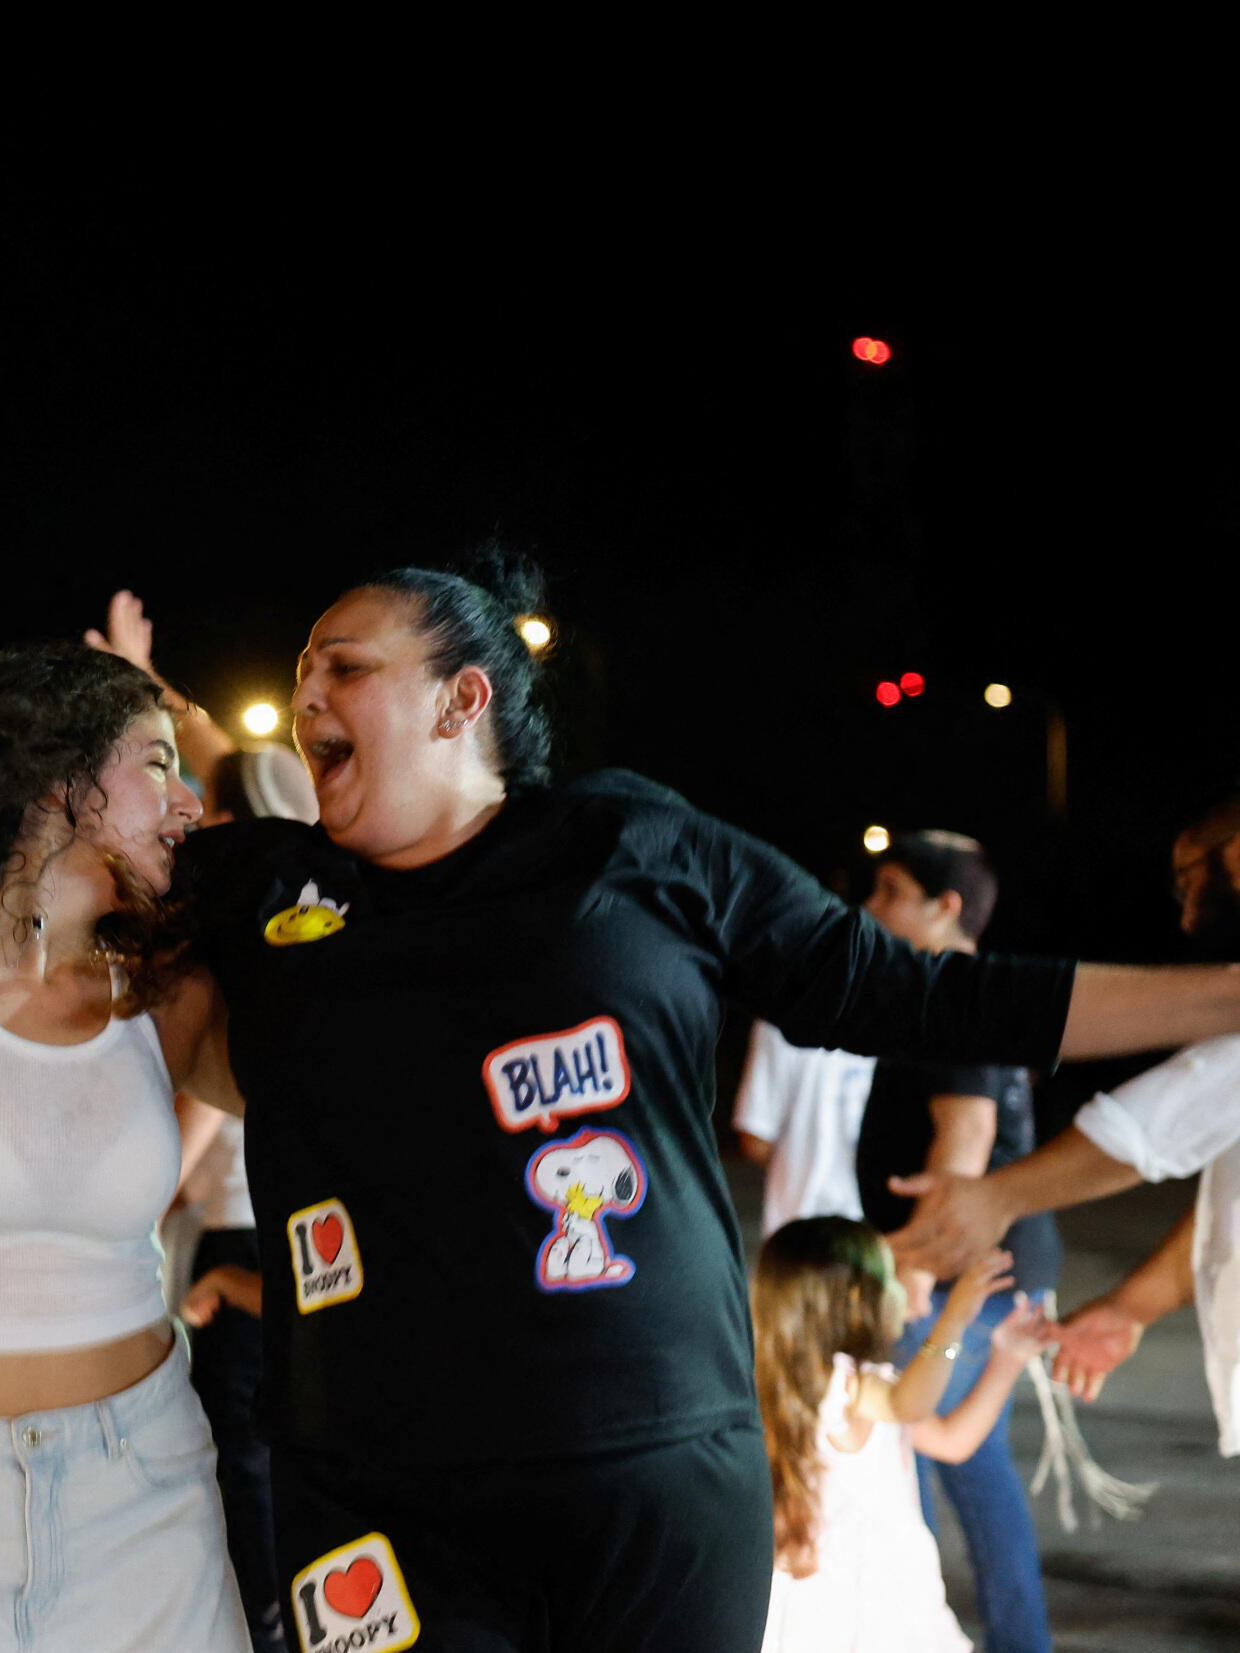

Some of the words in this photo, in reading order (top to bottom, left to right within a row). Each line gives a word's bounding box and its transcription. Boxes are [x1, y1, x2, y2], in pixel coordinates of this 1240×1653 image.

[502, 1031, 615, 1112] BLAH!
[295, 1223, 313, 1275] I
[299, 1580, 327, 1645] I
[315, 1610, 398, 1653] OOPY
